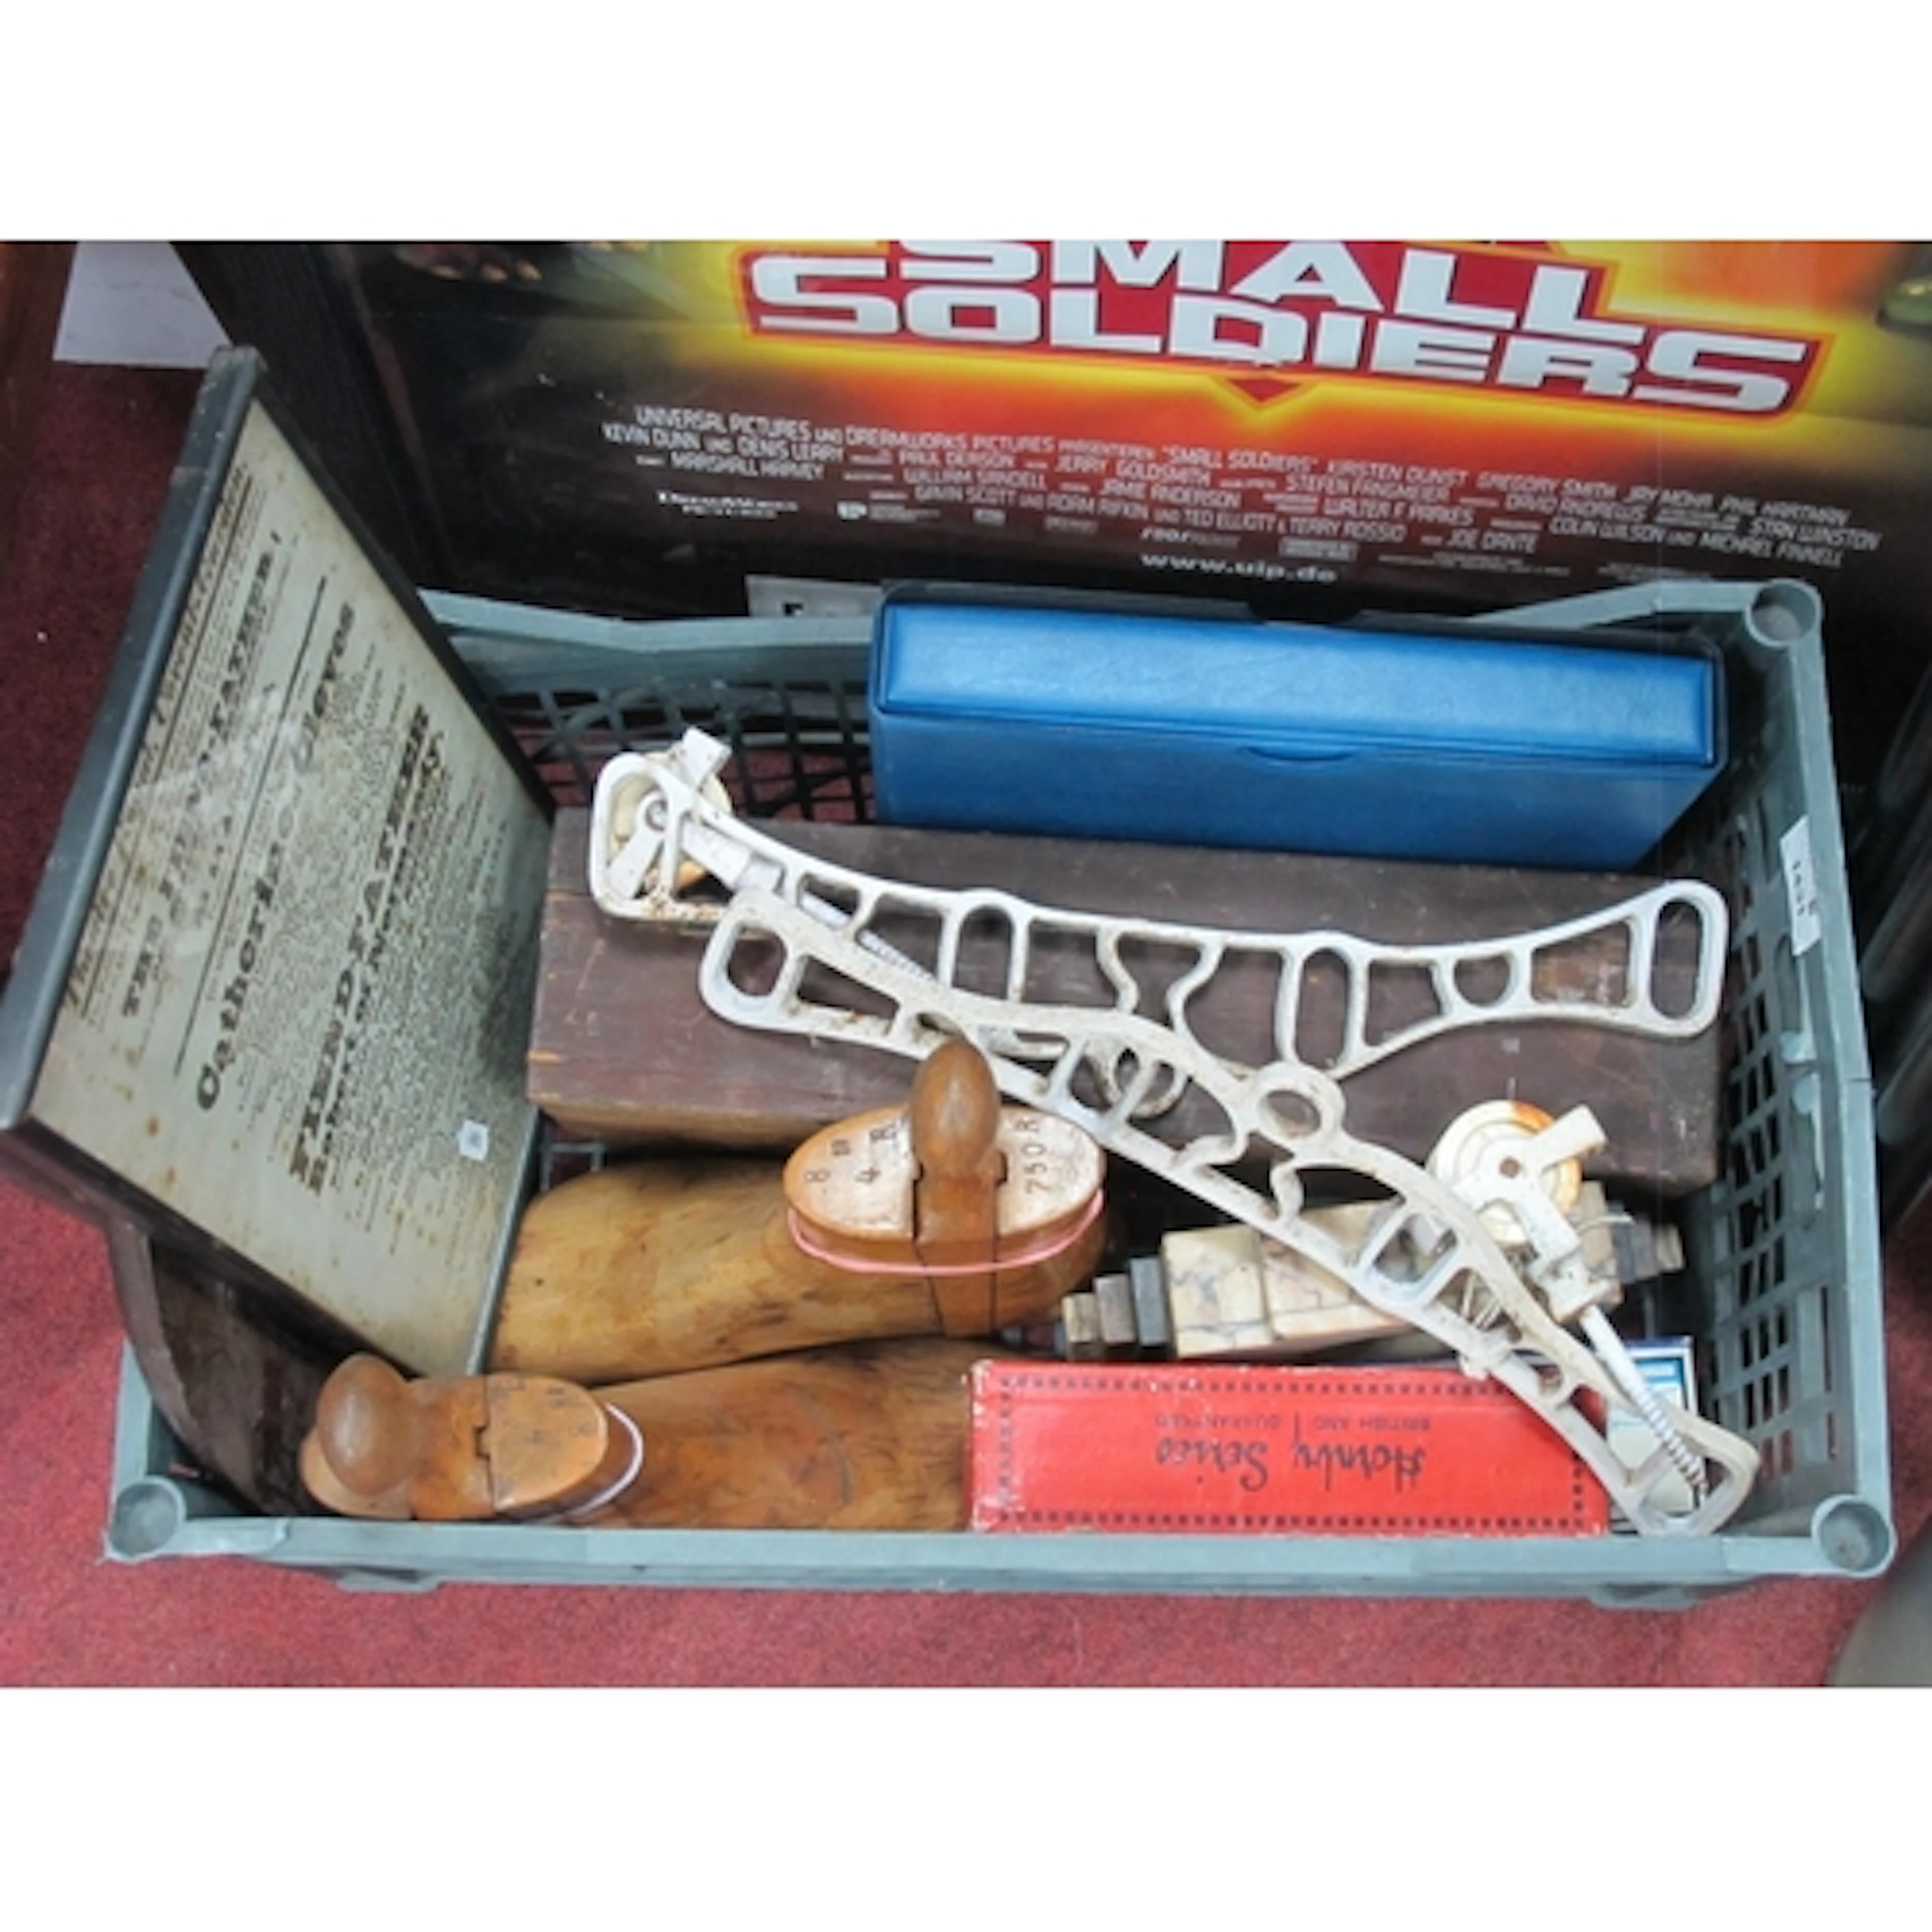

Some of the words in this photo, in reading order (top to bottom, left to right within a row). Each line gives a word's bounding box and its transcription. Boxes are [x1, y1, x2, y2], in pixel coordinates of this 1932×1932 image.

[899, 240, 1646, 344] SMALL
[751, 256, 1806, 412] SOLDIERS
[602, 422, 650, 445] KEVIN
[635, 406, 728, 433] UNIVERSAL
[729, 412, 810, 441] PICTURES
[973, 435, 1054, 453] PICTURES
[1141, 554, 1338, 583] www.uip.de
[1313, 1415, 1351, 1432] AND
[1359, 1415, 1431, 1432] BRITISH
[1154, 1438, 1269, 1493] Series
[1292, 1413, 1427, 1494] Hornby
